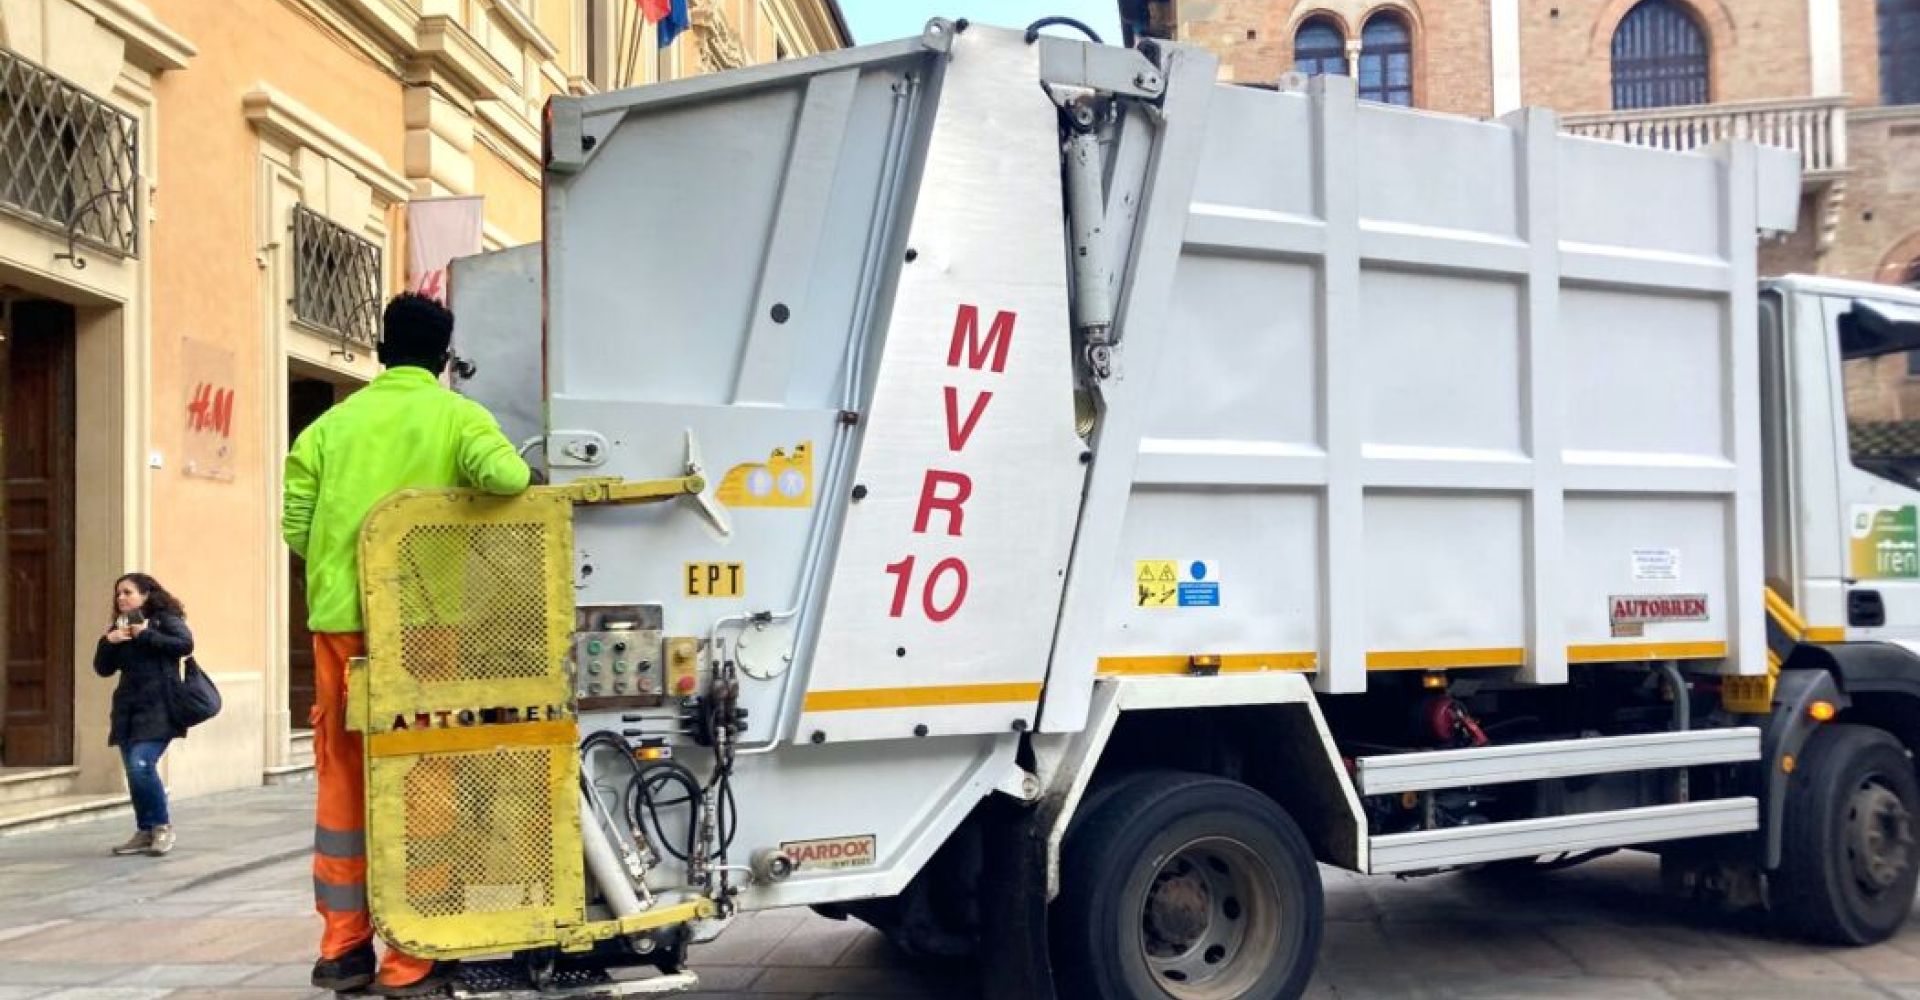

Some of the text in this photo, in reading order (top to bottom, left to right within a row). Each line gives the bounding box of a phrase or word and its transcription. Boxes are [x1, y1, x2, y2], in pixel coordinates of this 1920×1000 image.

[688, 564, 741, 595] EPT
[885, 554, 969, 622] 10
[1613, 598, 1706, 618] AUTOBREN
[786, 840, 872, 862] HARDOX
